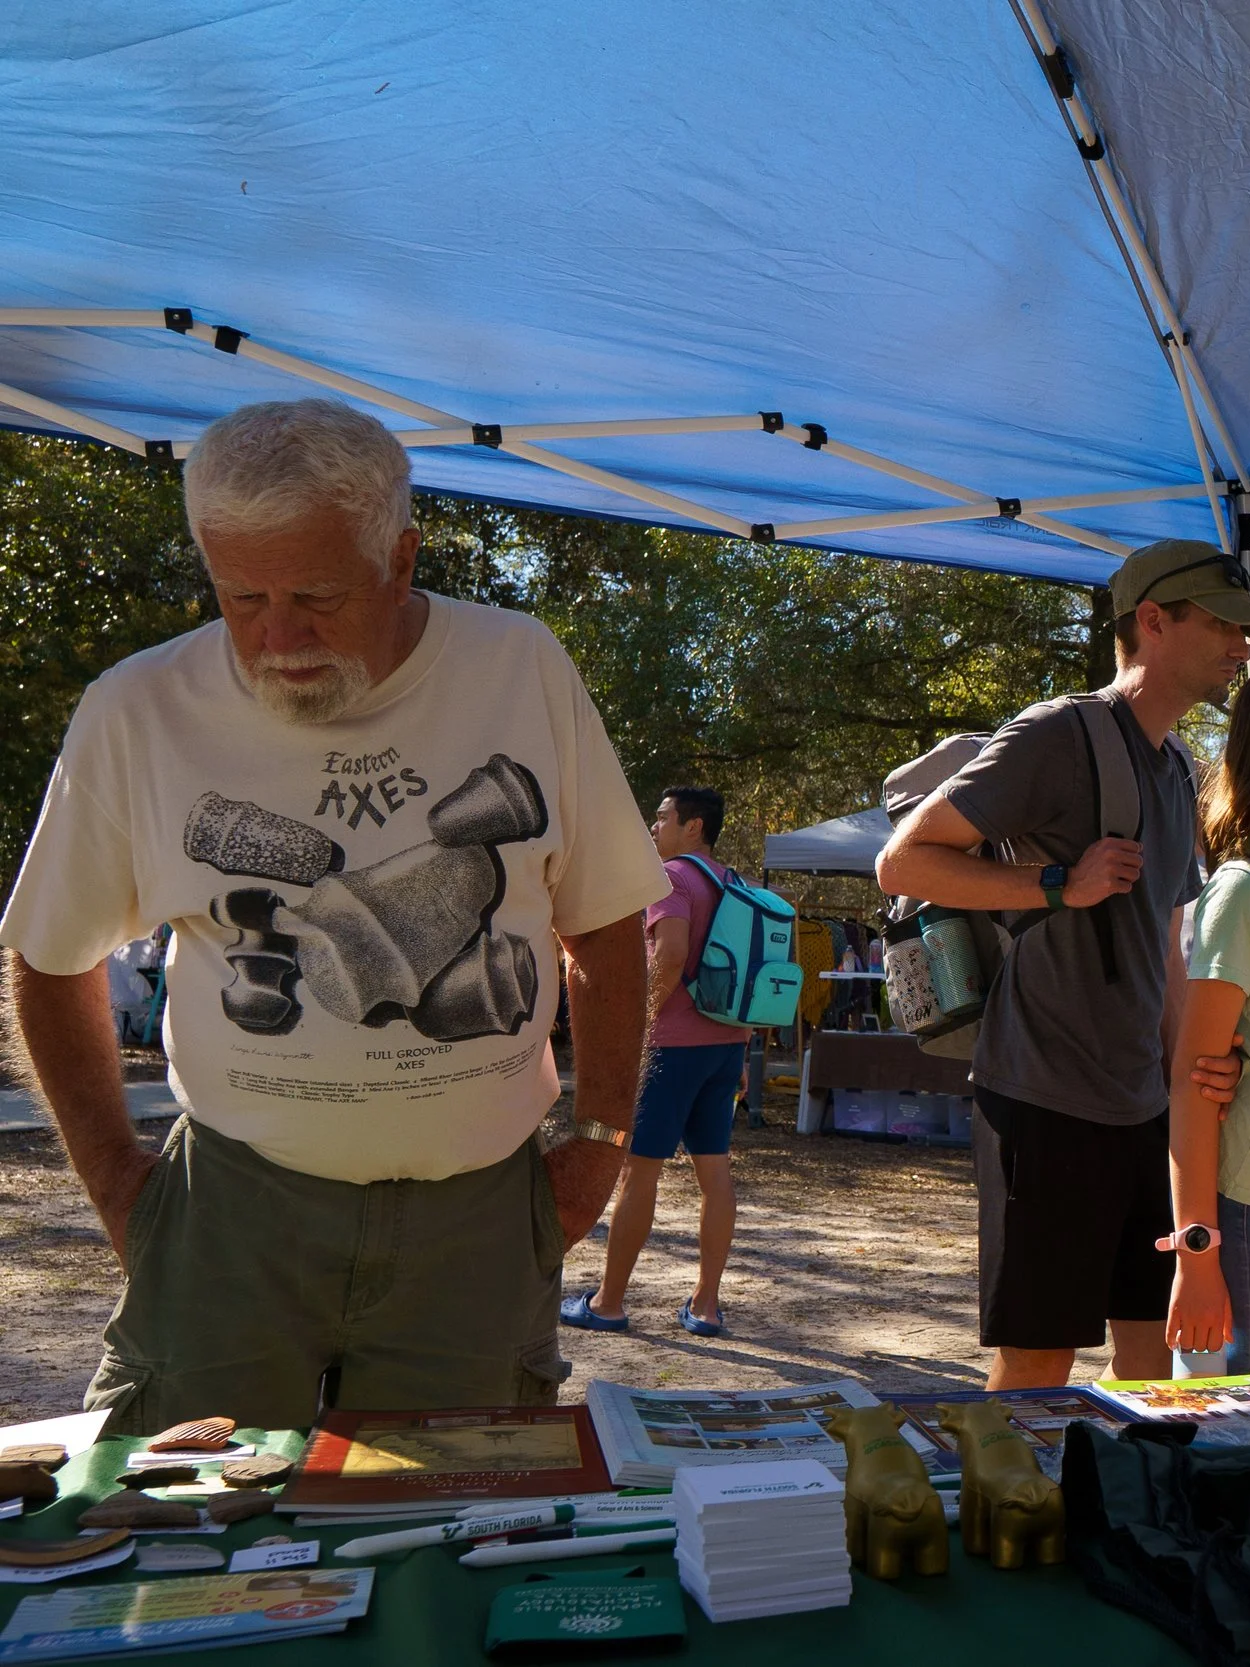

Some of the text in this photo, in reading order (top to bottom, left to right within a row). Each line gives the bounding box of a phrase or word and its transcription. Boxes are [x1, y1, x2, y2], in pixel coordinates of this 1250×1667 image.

[321, 746, 401, 776] Eastern
[314, 768, 429, 831] AXES
[365, 1044, 453, 1061] FULL GROOVED
[395, 1059, 426, 1072] AXES
[467, 1514, 543, 1536] SOUTH FLORIDA
[513, 1600, 662, 1613] FLORIDA PUBLIC
[519, 1595, 655, 1606] ARCHAEOLOGY
